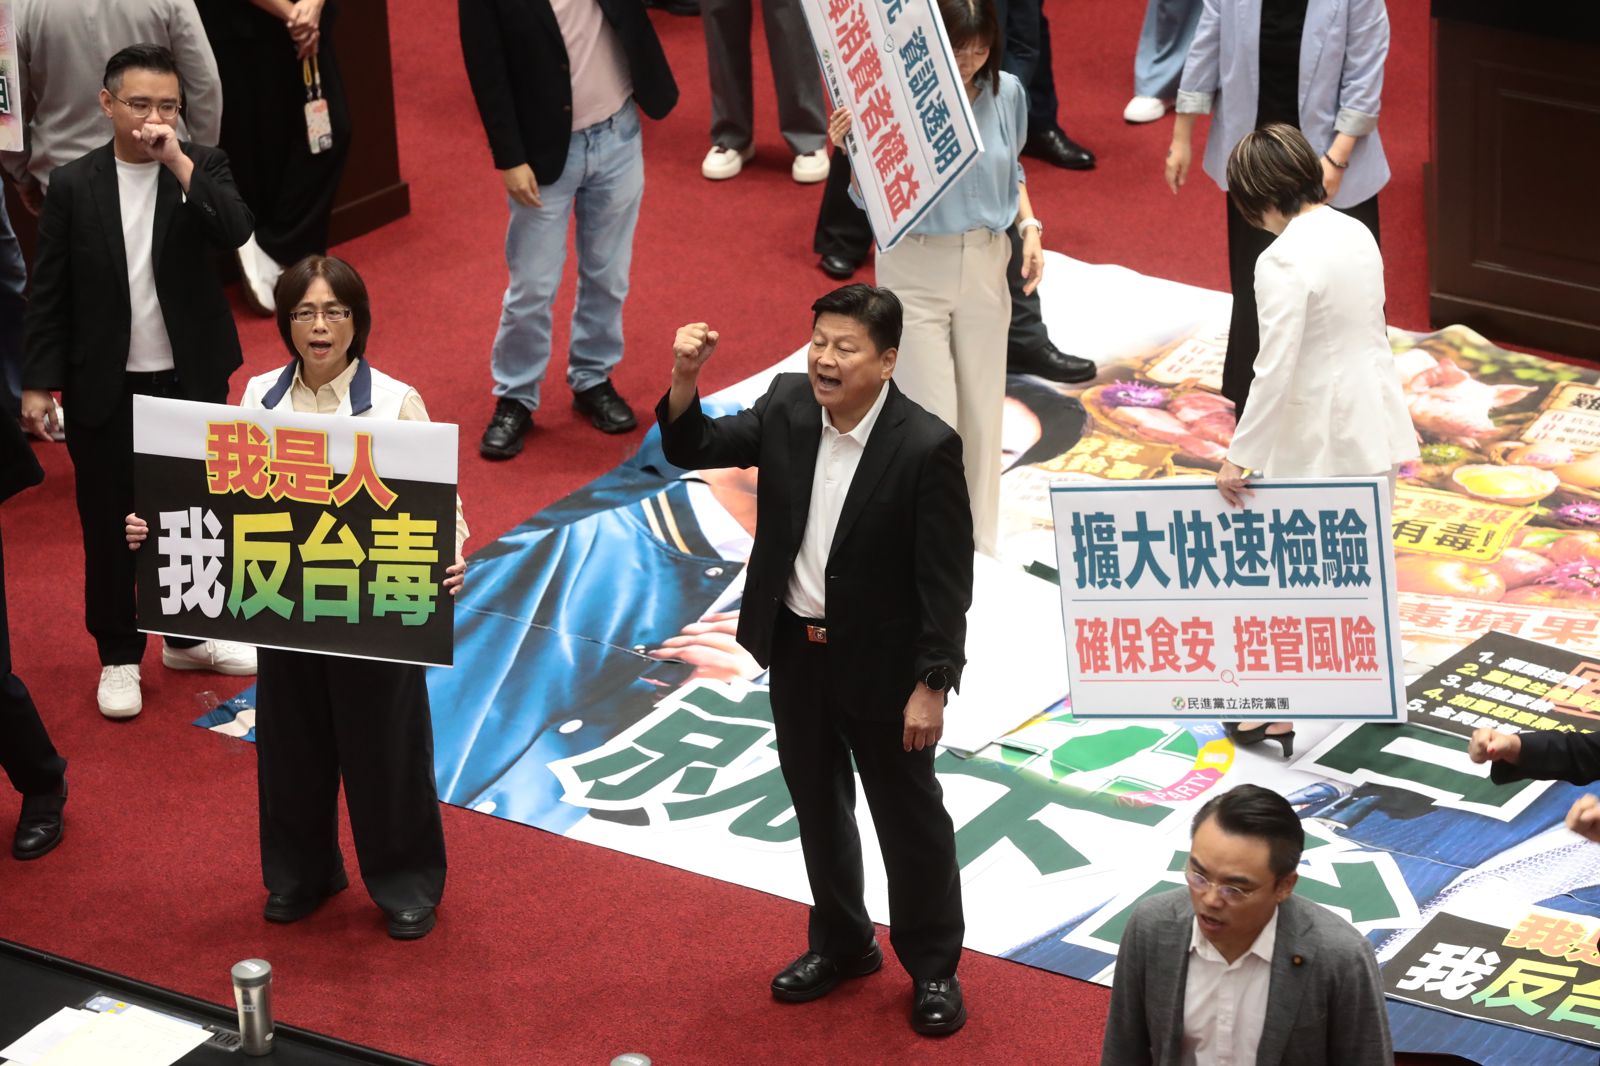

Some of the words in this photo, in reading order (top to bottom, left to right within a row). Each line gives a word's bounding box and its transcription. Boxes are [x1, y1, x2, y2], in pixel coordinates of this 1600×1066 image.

[899, 26, 962, 175] 資訊透明
[206, 420, 398, 511] 我是人
[158, 506, 440, 627] 我反台毒
[1071, 509, 1372, 589] 擴大快速檢驗
[1075, 617, 1217, 675] 確保食安
[1233, 615, 1379, 673] 控管風險
[1187, 697, 1290, 710] 民進黨立法院黨團
